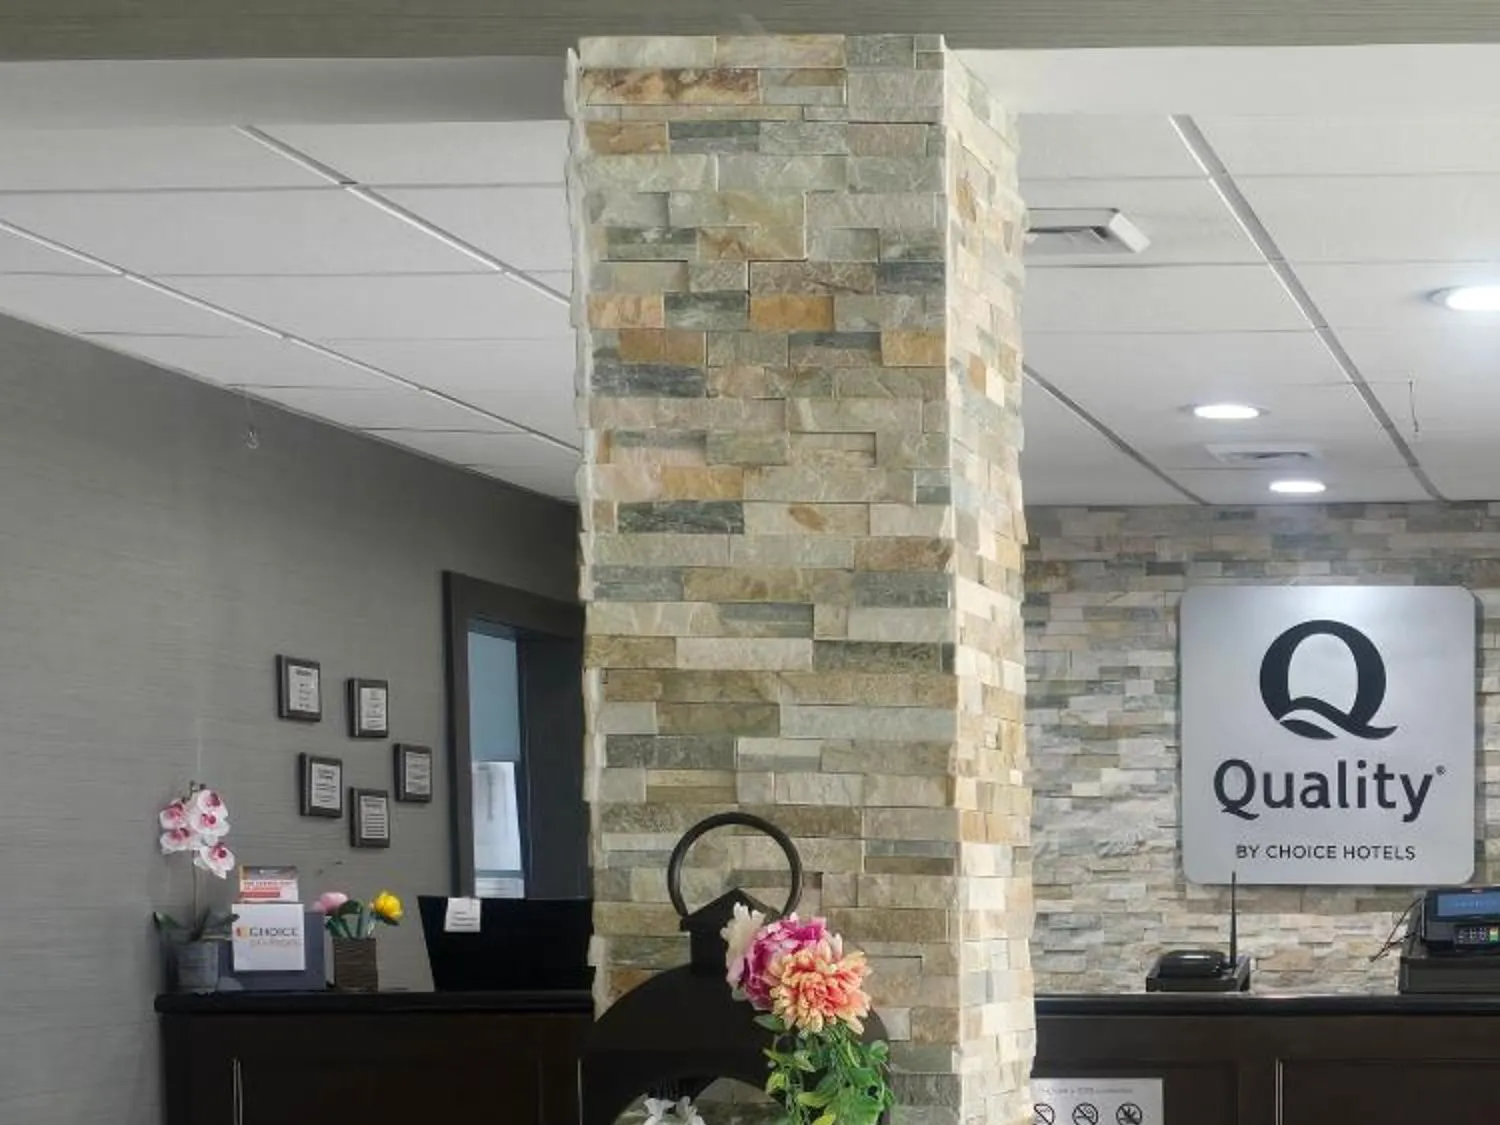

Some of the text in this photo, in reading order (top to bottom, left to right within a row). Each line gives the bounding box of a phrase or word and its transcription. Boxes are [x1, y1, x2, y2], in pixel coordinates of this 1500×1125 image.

[1259, 618, 1398, 741] Q
[1236, 844, 1417, 861] BY CHOICE HOTELS
